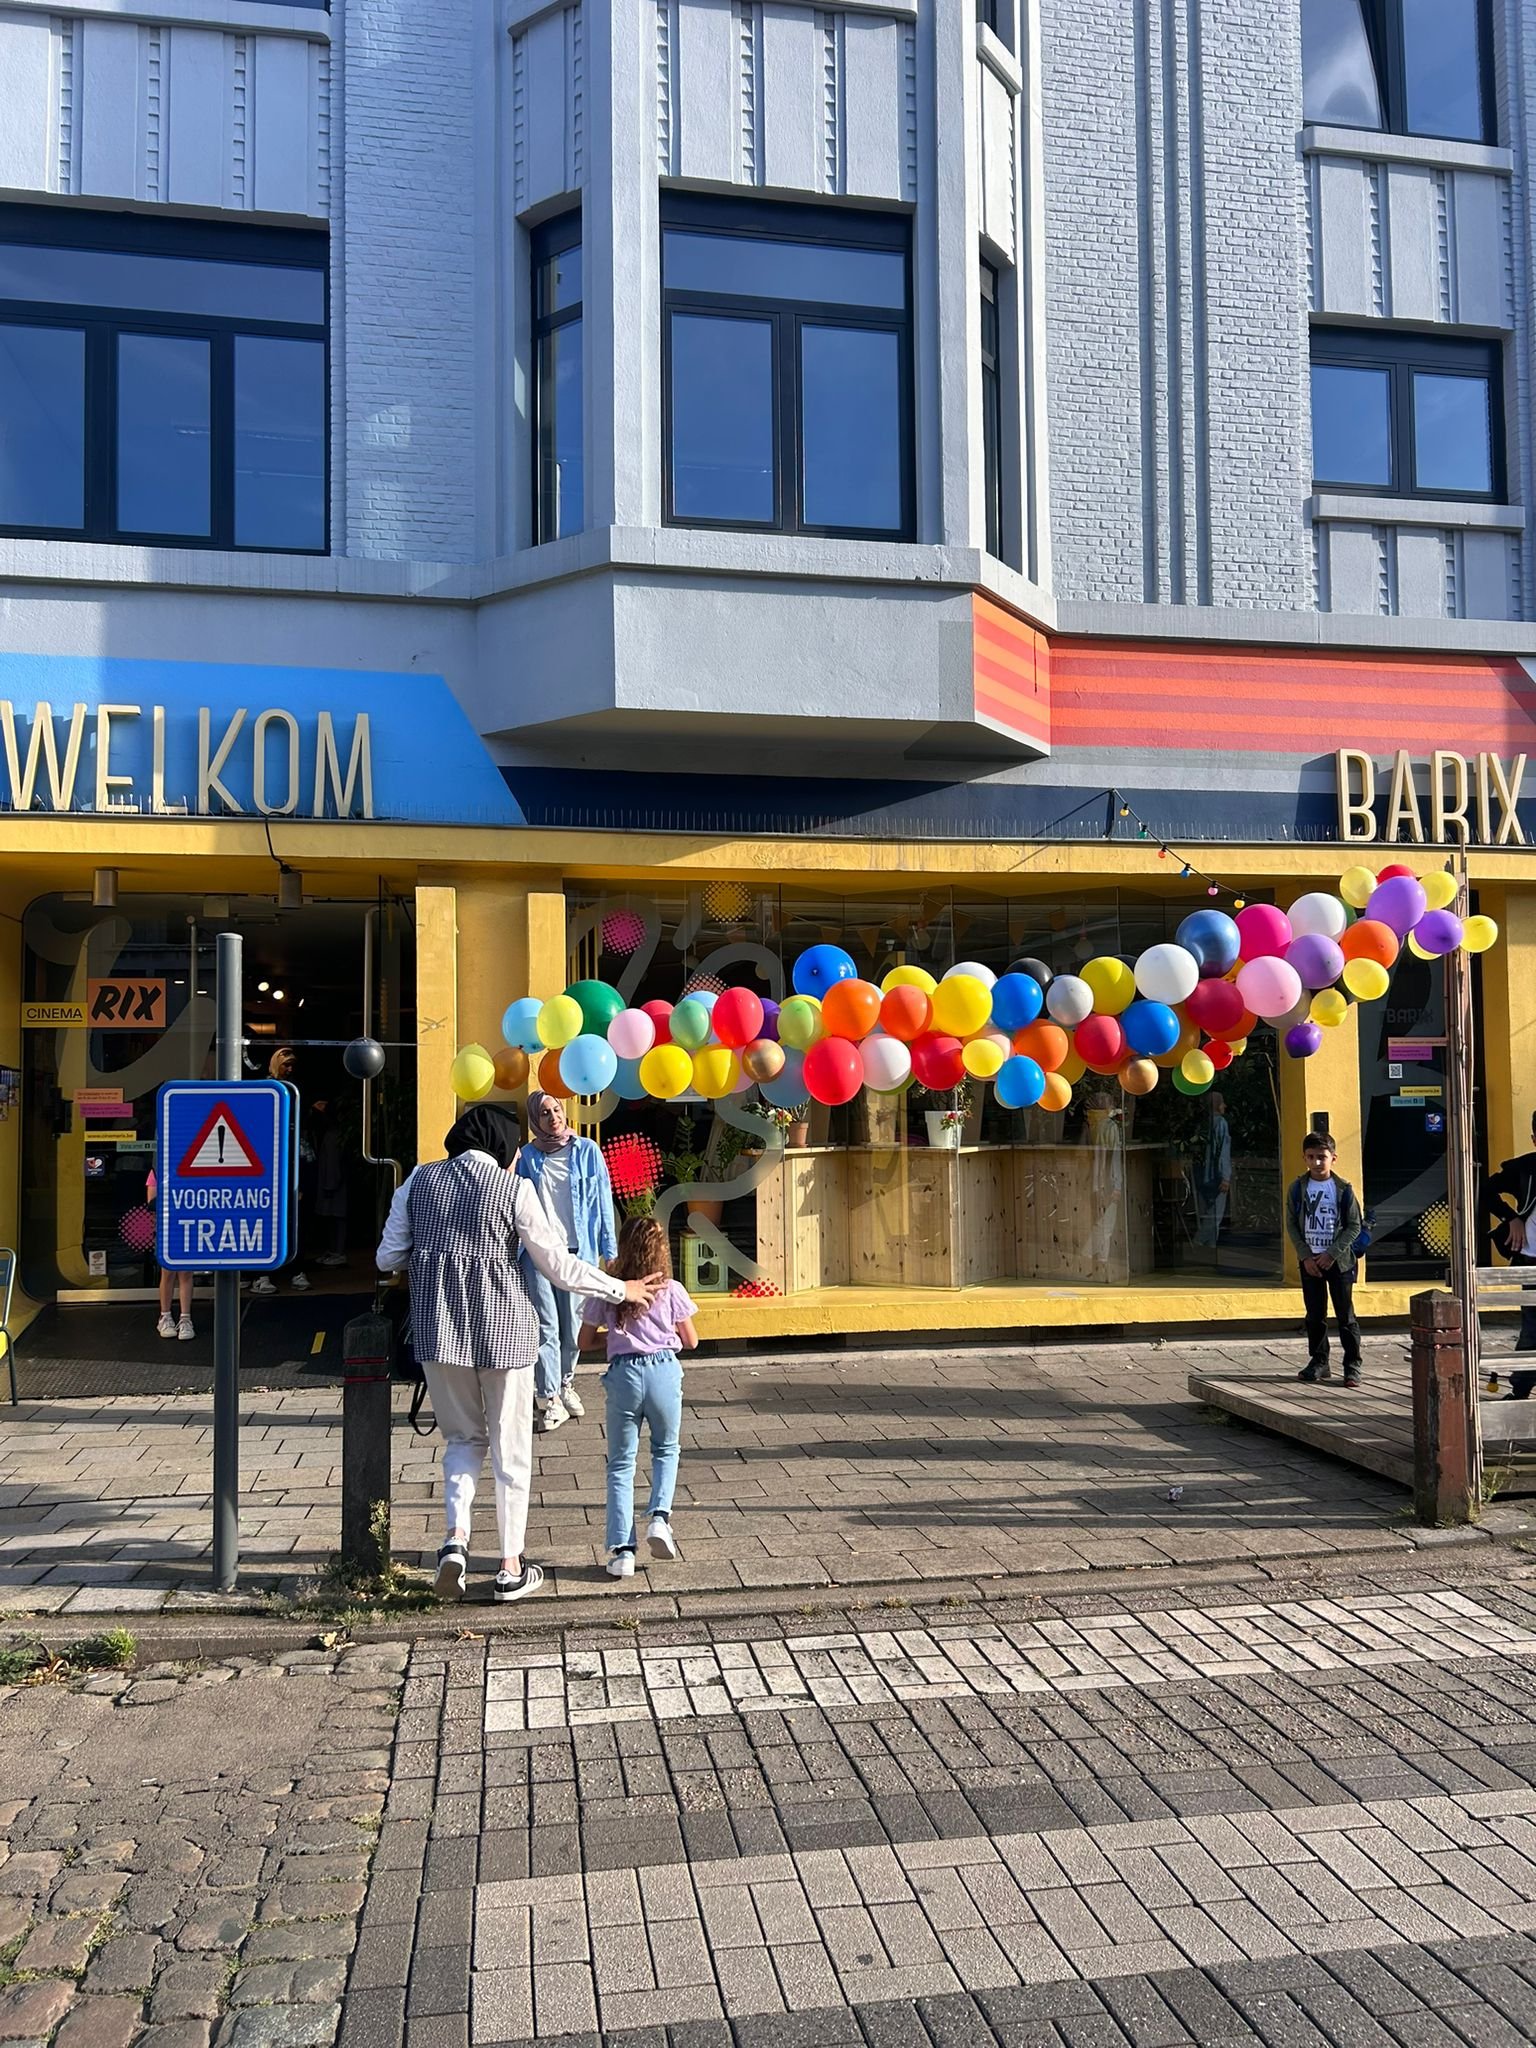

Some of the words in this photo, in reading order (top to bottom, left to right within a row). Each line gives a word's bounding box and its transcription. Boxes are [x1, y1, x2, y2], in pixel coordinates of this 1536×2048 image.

[0, 701, 374, 818] WELKOM
[1336, 748, 1527, 844] BARIX
[26, 1008, 83, 1022] CINEMA
[91, 985, 162, 1021] RIX
[172, 1188, 270, 1209] VOORRANG
[178, 1219, 263, 1252] TRAM
